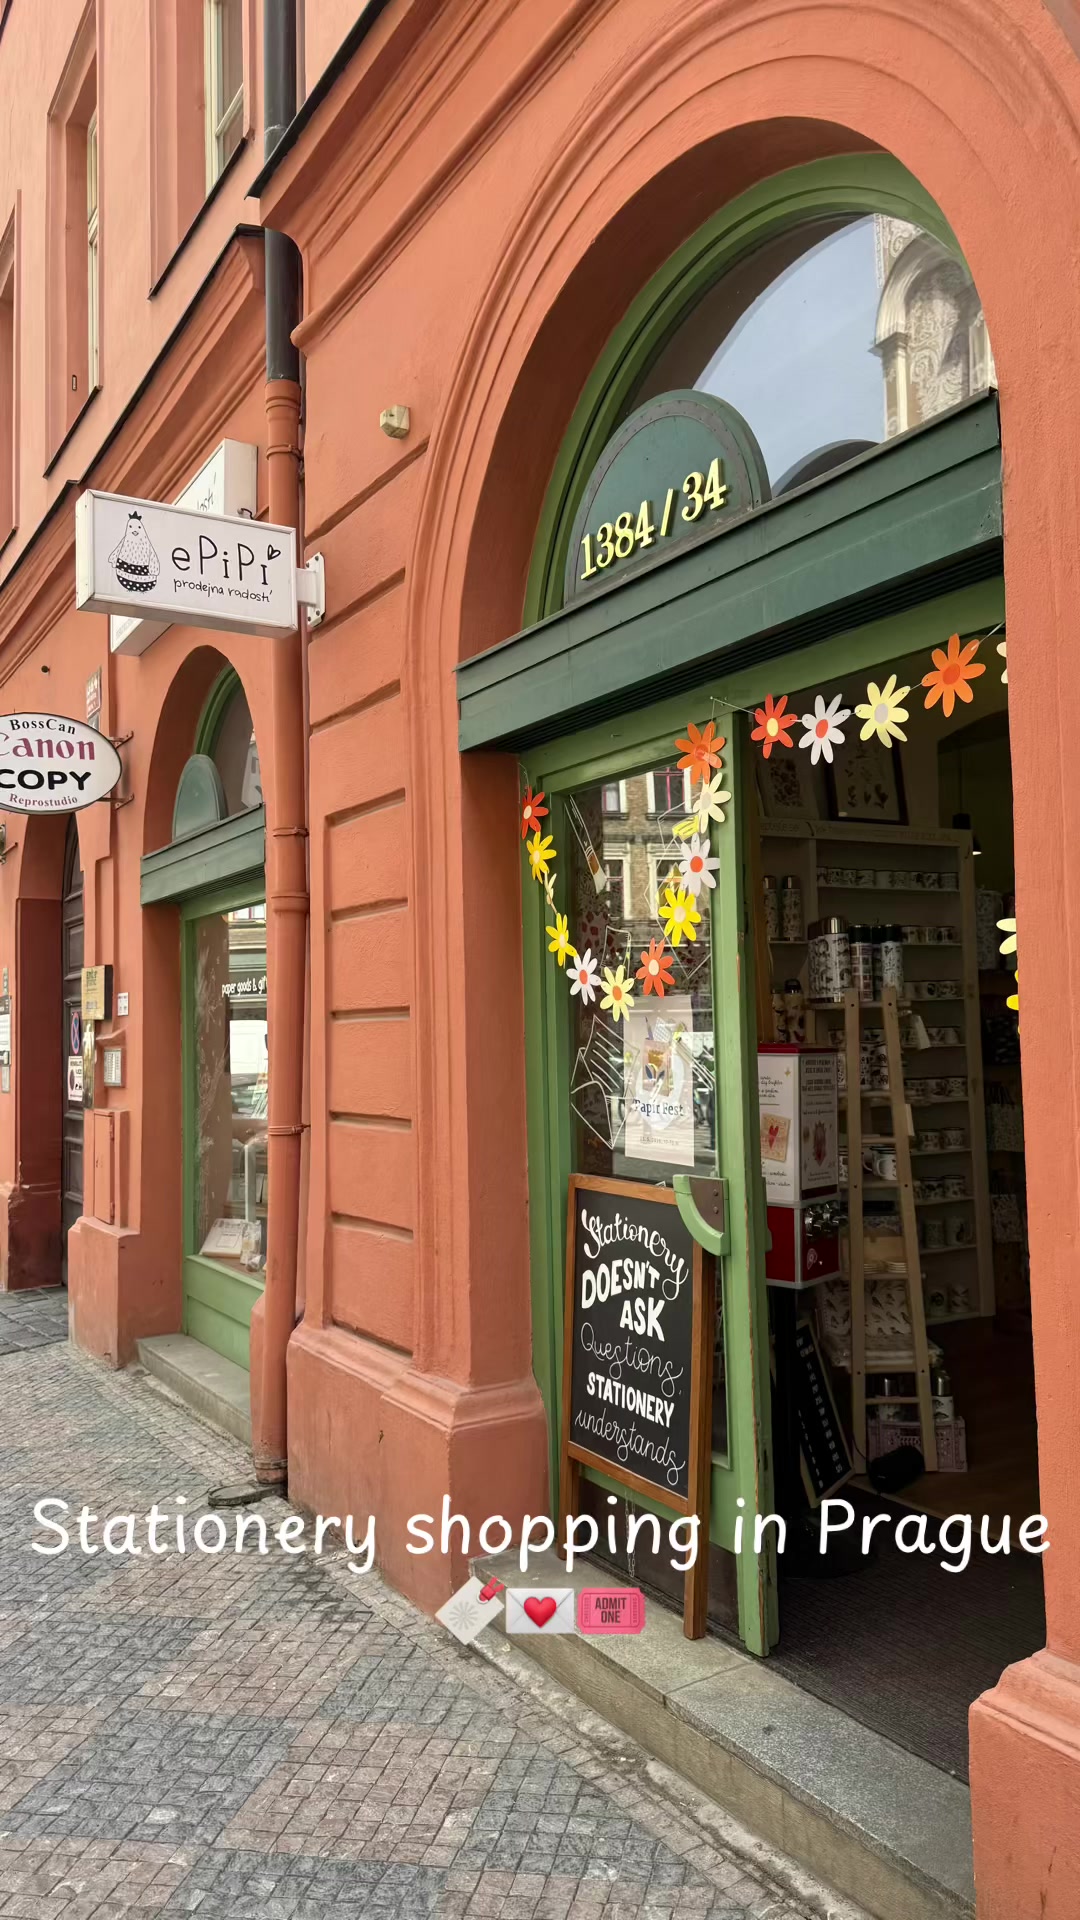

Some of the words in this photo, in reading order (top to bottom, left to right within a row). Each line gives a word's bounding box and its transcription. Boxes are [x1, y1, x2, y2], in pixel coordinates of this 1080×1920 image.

[173, 578, 225, 598] prodejna
[9, 718, 76, 735] BossCan
[9, 793, 78, 807] Reprostudio
[581, 1208, 689, 1301] Stationery
[581, 1257, 661, 1309] DOESN'T
[619, 1296, 665, 1342] ASK
[586, 1371, 675, 1429] STATIONERY
[574, 1407, 686, 1486] understands
